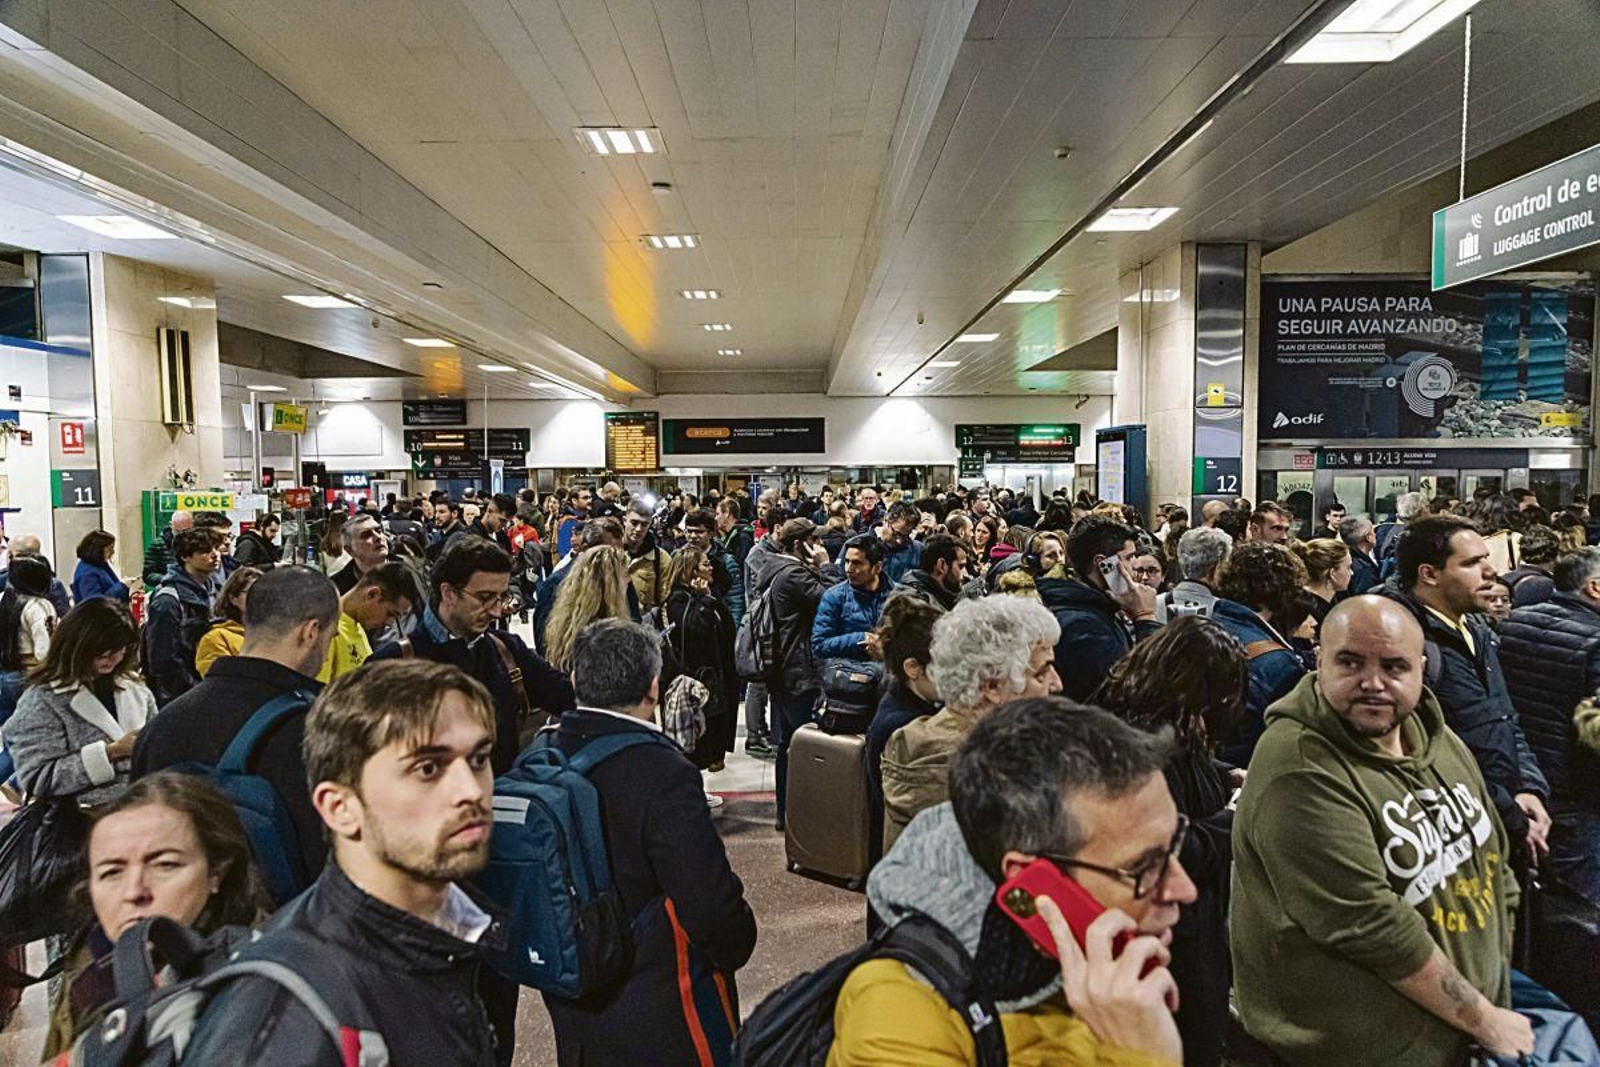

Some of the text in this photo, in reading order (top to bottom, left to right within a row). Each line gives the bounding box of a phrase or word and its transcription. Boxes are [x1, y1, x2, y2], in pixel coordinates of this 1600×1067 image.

[1494, 173, 1600, 226] Control de e
[1493, 209, 1595, 256] LUGGAGE CONTROL
[1278, 296, 1433, 313] UNA PAUSA PARA
[1277, 318, 1457, 335] SEGUIR AVANZANDO
[1277, 343, 1296, 351] PLAN
[1297, 343, 1306, 351] DE
[1308, 341, 1347, 350] CERCANÍAS
[284, 412, 304, 425] ONCE
[1290, 412, 1325, 425] adif
[410, 442, 423, 452] 10
[512, 441, 523, 450] 11
[963, 436, 973, 445] 12
[343, 475, 368, 486] CASA
[1216, 475, 1238, 493] 12
[74, 486, 96, 505] 11
[184, 496, 230, 507] ONCE
